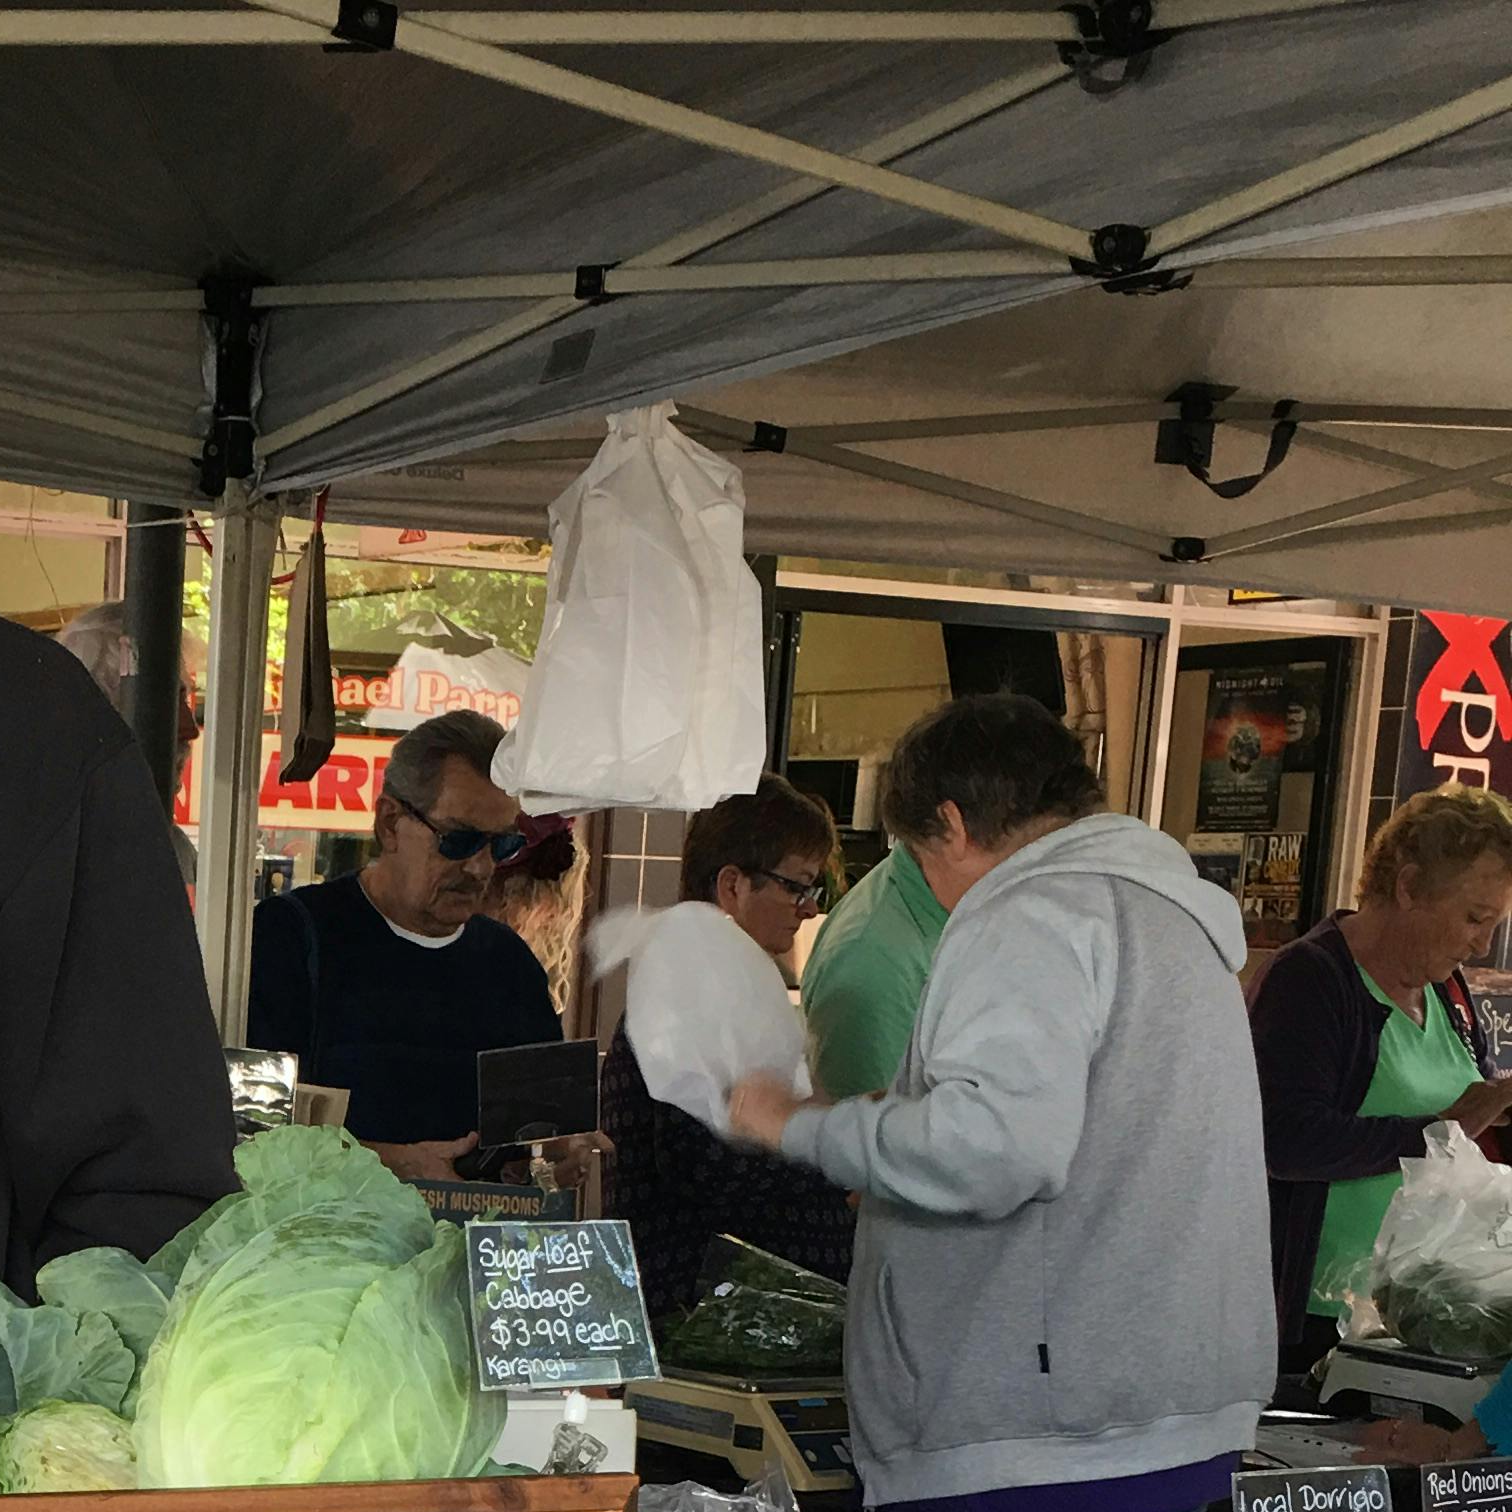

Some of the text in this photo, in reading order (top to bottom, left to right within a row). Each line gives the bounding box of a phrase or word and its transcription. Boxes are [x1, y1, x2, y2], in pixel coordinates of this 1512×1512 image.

[1268, 835, 1302, 861] RAW
[450, 1191, 540, 1216] MUSHROOMS
[485, 1281, 593, 1318] Cabbage
[489, 1311, 636, 1351] $3.99 each
[486, 1351, 568, 1380] Karangi
[1427, 1468, 1512, 1499] Red Onions
